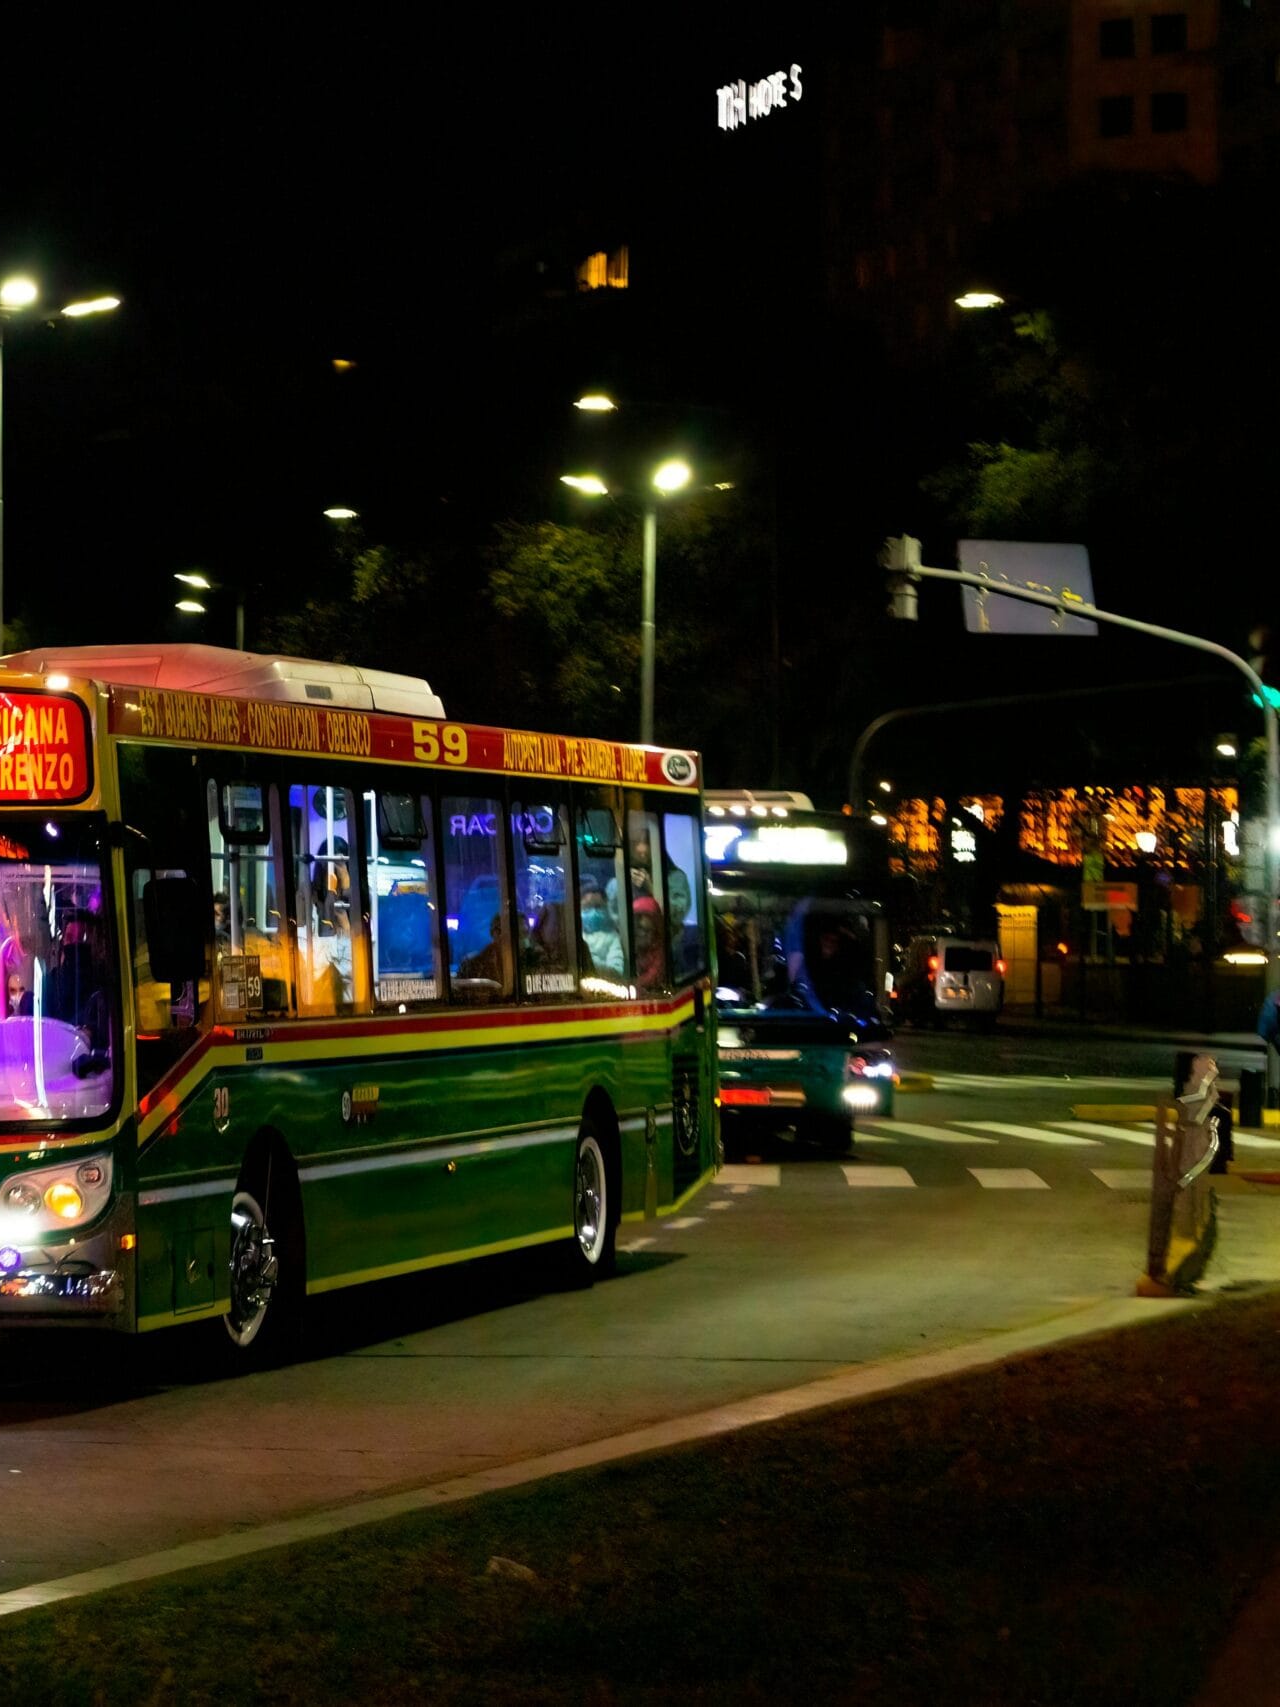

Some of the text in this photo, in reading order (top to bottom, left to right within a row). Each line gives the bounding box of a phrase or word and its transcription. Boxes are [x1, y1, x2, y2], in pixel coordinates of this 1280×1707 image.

[749, 63, 803, 120] HOTES
[210, 698, 241, 744] AIRES
[247, 702, 320, 751] CONSTITUCION
[326, 711, 370, 756] OBELISCO
[412, 720, 468, 765] 59
[247, 976, 261, 998] 59
